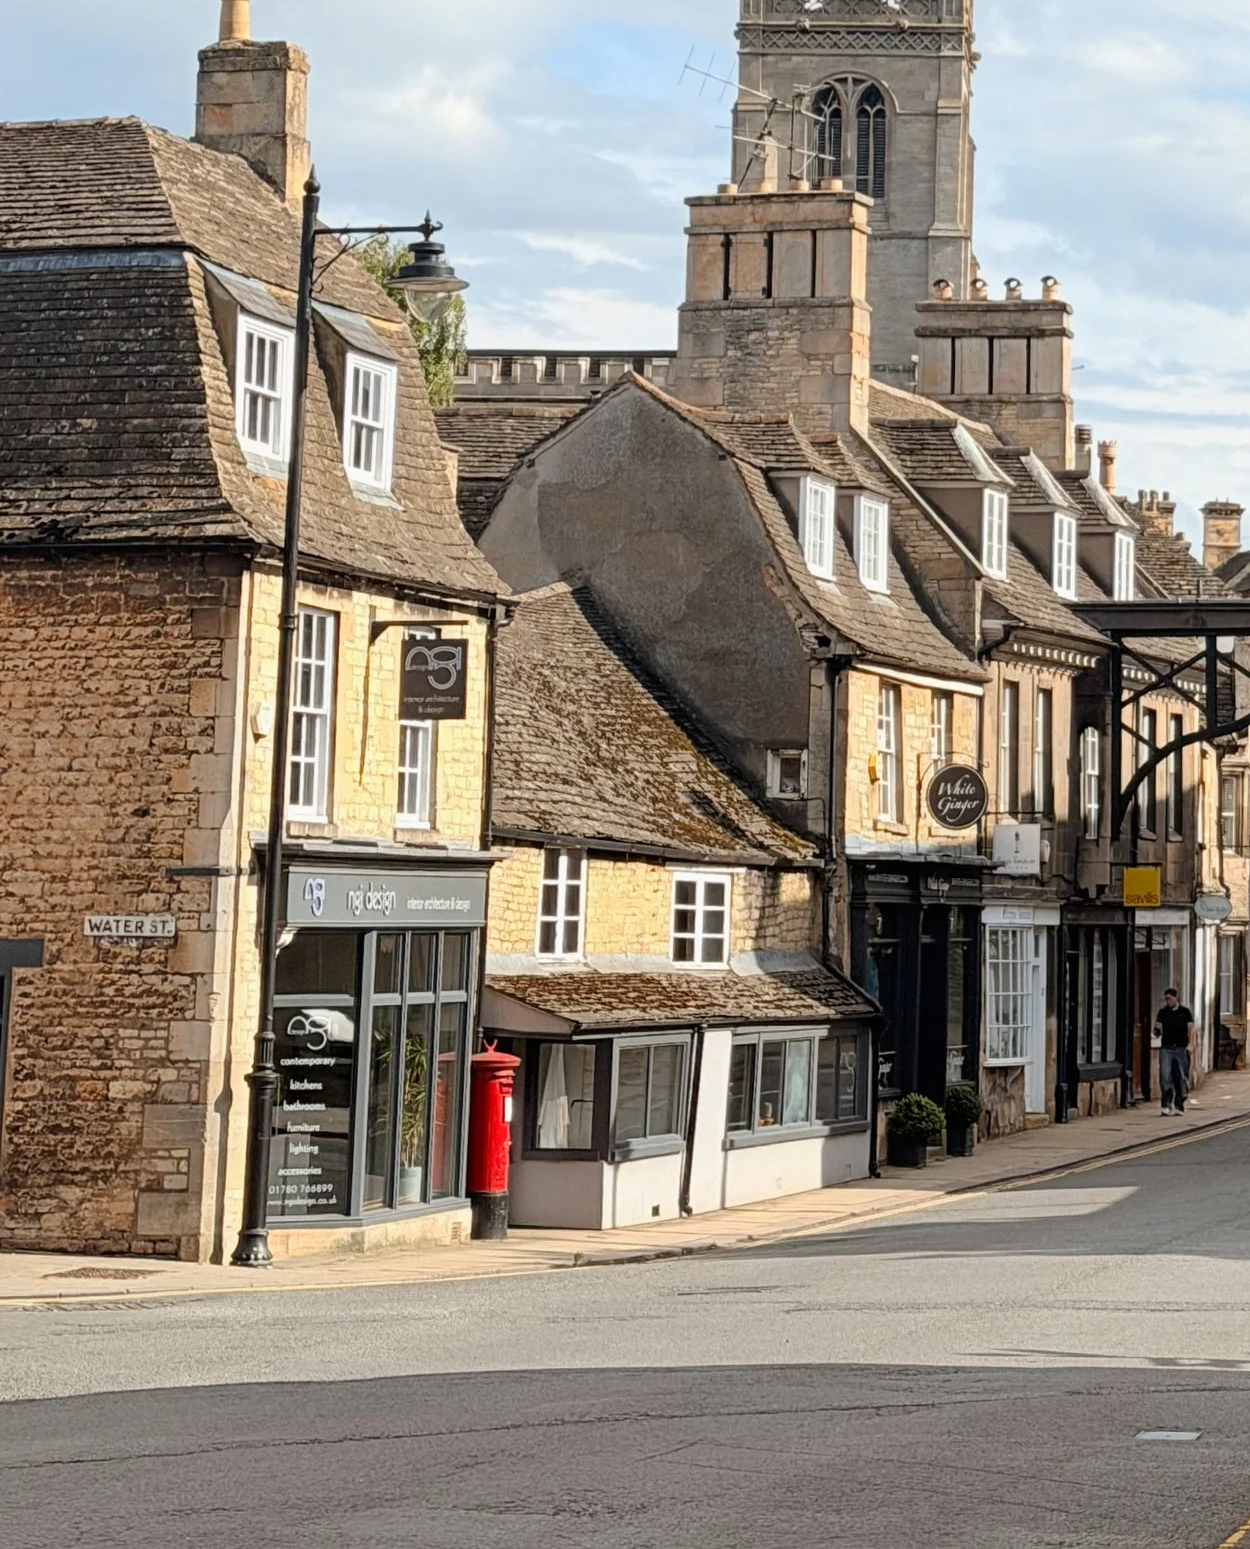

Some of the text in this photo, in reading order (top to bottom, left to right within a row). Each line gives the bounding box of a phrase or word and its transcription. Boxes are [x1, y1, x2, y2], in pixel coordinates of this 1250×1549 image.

[937, 774, 976, 796] White
[937, 796, 980, 823] Ginger
[348, 884, 363, 916] ngi
[365, 881, 397, 915] design
[88, 918, 172, 934] WATER ST.
[280, 1057, 336, 1067] contemporary
[289, 1078, 323, 1090] kitchens
[283, 1099, 326, 1110] bathrooms
[286, 1121, 320, 1132] furniture
[289, 1141, 319, 1155] lighting
[277, 1166, 322, 1176] accessories
[268, 1183, 333, 1194] 01780 766899
